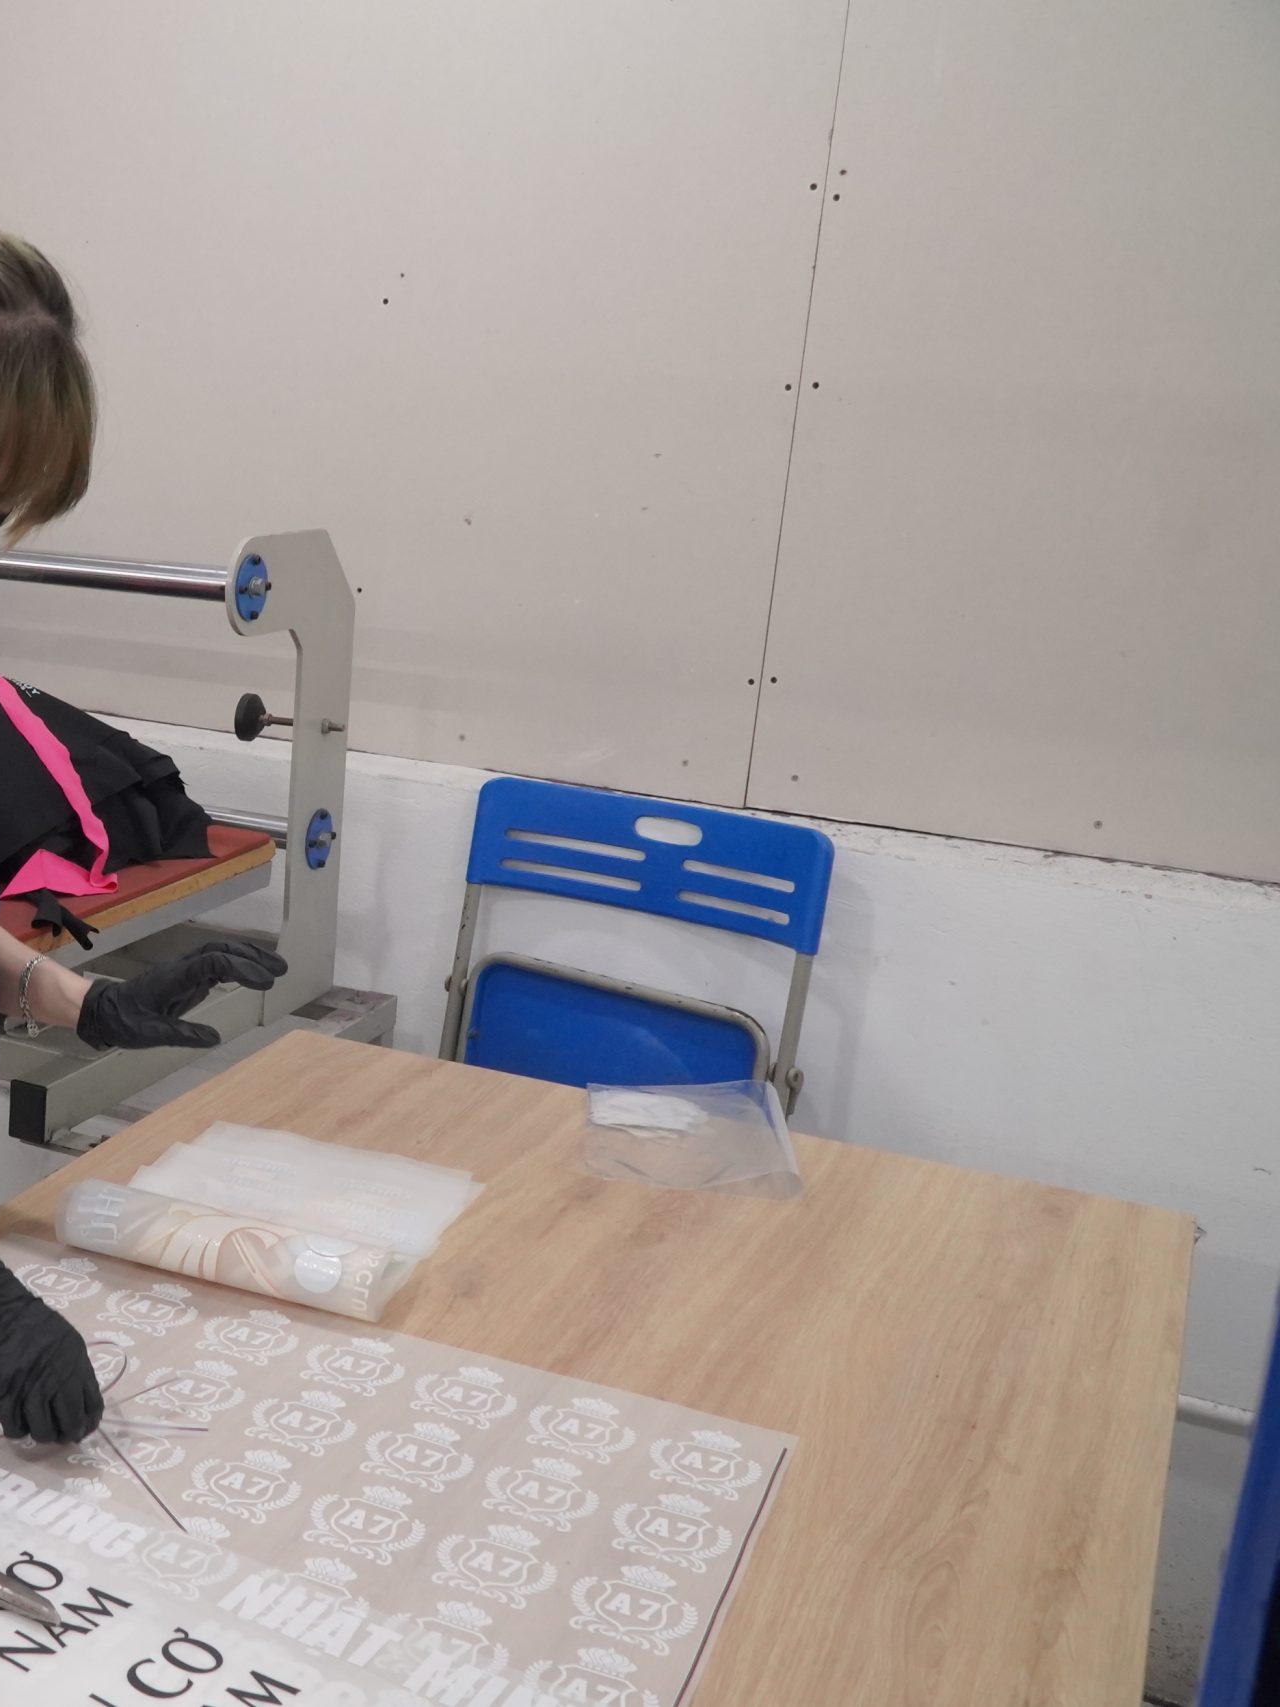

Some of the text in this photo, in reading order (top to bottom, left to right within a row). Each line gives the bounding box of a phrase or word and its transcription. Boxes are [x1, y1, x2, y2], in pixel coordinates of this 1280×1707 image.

[34, 1273, 77, 1290] A7
[128, 1299, 169, 1317] A7
[226, 1326, 273, 1346] A7
[332, 1355, 378, 1374] A7
[172, 1378, 217, 1399] A7
[440, 1386, 488, 1406] A7
[279, 1410, 326, 1432] A7
[556, 1418, 605, 1440] A7
[393, 1444, 444, 1467] A7
[679, 1451, 728, 1473] A7
[220, 1471, 272, 1495] A7
[515, 1480, 568, 1505] A7
[340, 1509, 393, 1535] A7
[645, 1516, 698, 1543] A7
[468, 1551, 522, 1578] A7
[605, 1592, 662, 1622] A7
[126, 1626, 224, 1699] CƠ
